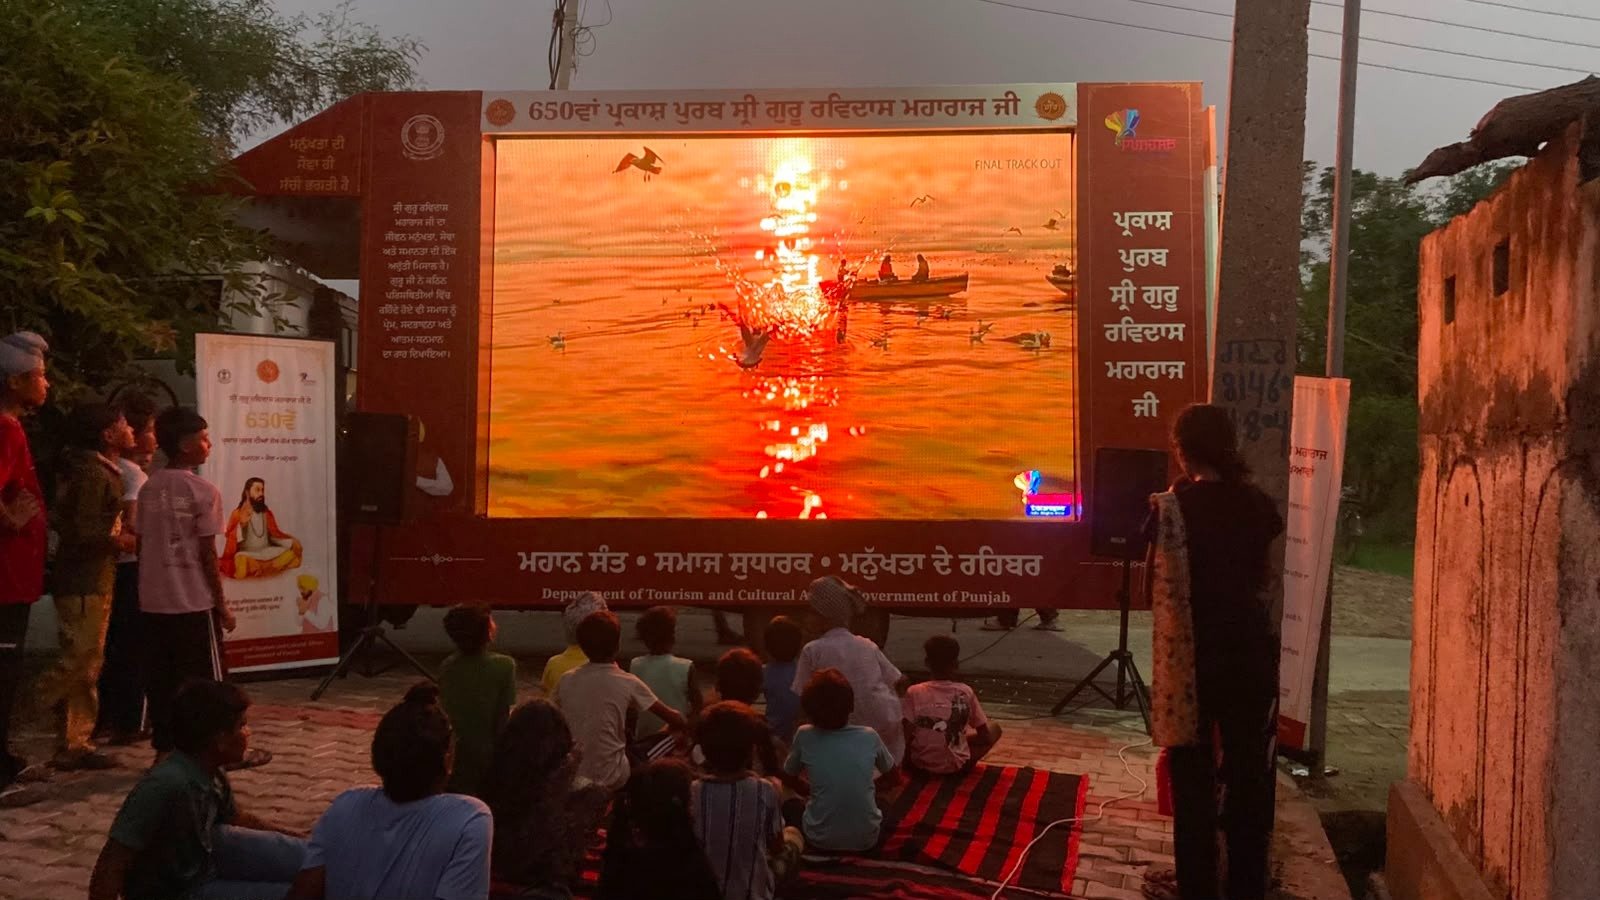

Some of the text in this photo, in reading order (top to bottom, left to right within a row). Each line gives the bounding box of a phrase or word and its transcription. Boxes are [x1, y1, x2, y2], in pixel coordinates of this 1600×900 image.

[528, 91, 1021, 127] 650ਵਾਂ ਪ੍ਰਕਾਸ਼ ਪੁਰਬ ਸ੍ਰੀ ਗੁਰੂ ਰਵਿਦਾਸ ਮਹਾਰਾਜ ਜੀ
[975, 158, 1062, 170] FINAL TRACK OUT
[1113, 211, 1173, 237] ਪ੍ਰਕਾਸ਼
[1118, 249, 1169, 272] ਪੁਰਬ
[1108, 278, 1179, 312] ਸ੍ਰੀ ਗੁਰੂ
[1104, 316, 1186, 343] ਰਵਿਦਾਸ
[1105, 361, 1185, 379] ਮਹਾਰਾਜ
[1131, 391, 1160, 417] ਜੀ
[517, 545, 1043, 581] ਮਹਾਨ ਸੰਤ ਸਮਾਜ ਸੁਧਾਰਕ ਮਨੁੱਖਤਾ ਦੇ ਰਹਿਬਰ
[629, 588, 644, 600] of
[645, 588, 704, 600] Tourism
[708, 589, 734, 600] and
[738, 588, 795, 600] Cultural
[861, 590, 1010, 606] overnment of Punjab
